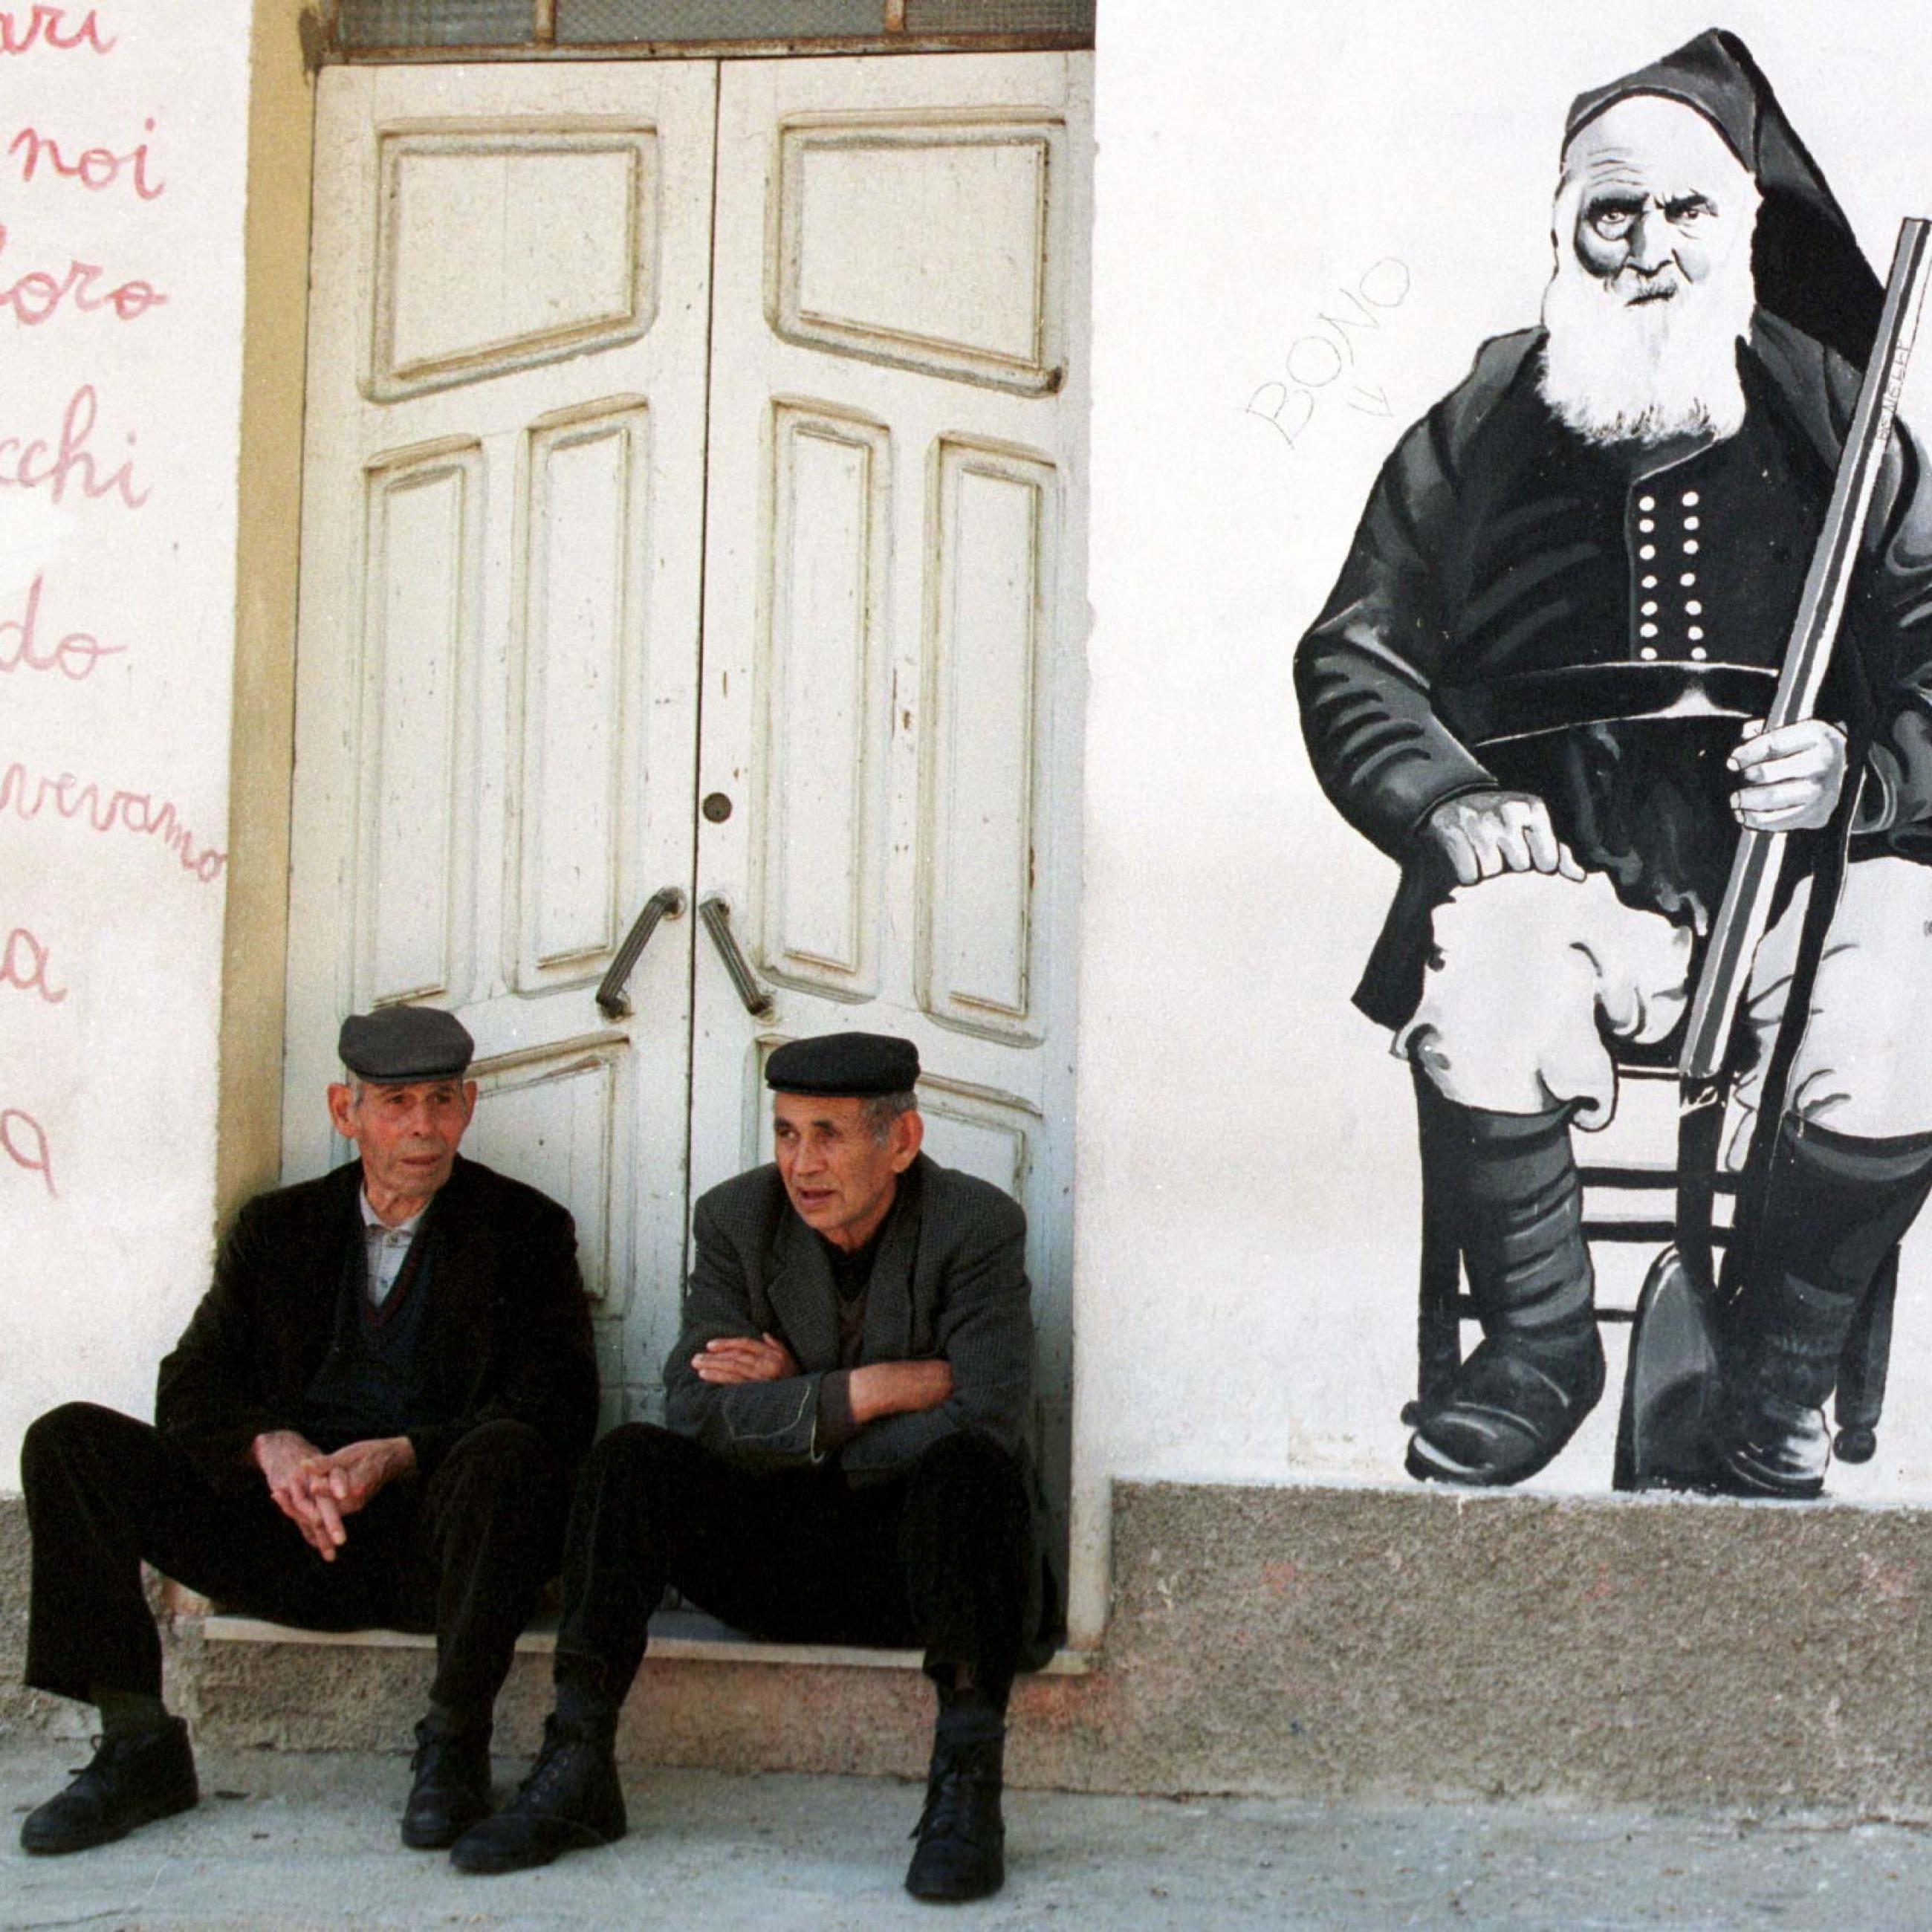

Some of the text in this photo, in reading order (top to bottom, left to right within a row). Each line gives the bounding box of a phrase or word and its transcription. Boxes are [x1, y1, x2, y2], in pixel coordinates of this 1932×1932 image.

[8, 117, 166, 201] noi
[0, 223, 169, 327] oro
[1242, 256, 1410, 450] BONO
